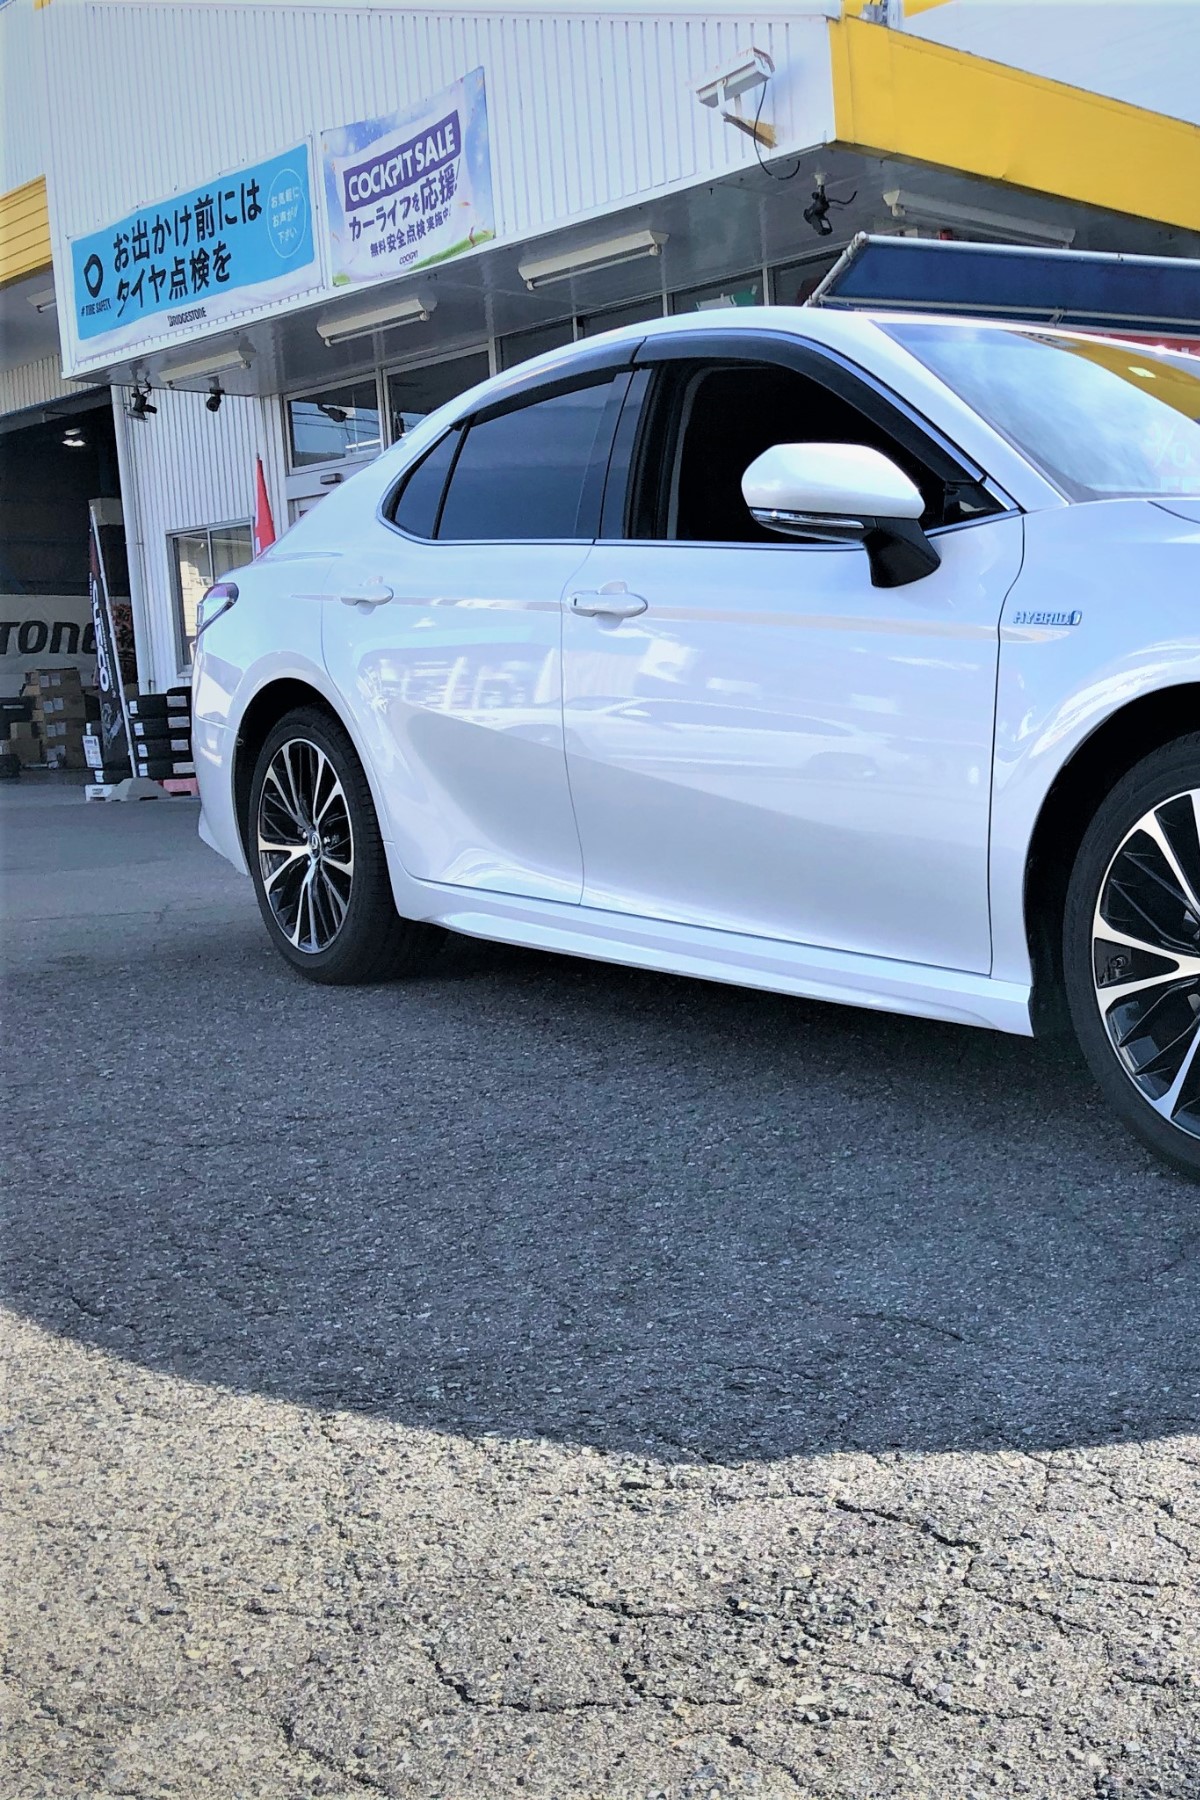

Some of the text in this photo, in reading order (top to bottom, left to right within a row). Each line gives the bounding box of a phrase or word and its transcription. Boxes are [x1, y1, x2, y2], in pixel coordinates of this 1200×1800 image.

[348, 123, 456, 203] COCKPIT SALE
[113, 178, 262, 273] お出かけ前には
[117, 241, 231, 318] タイヤ点検を
[167, 307, 207, 327] BRIDGESTONE
